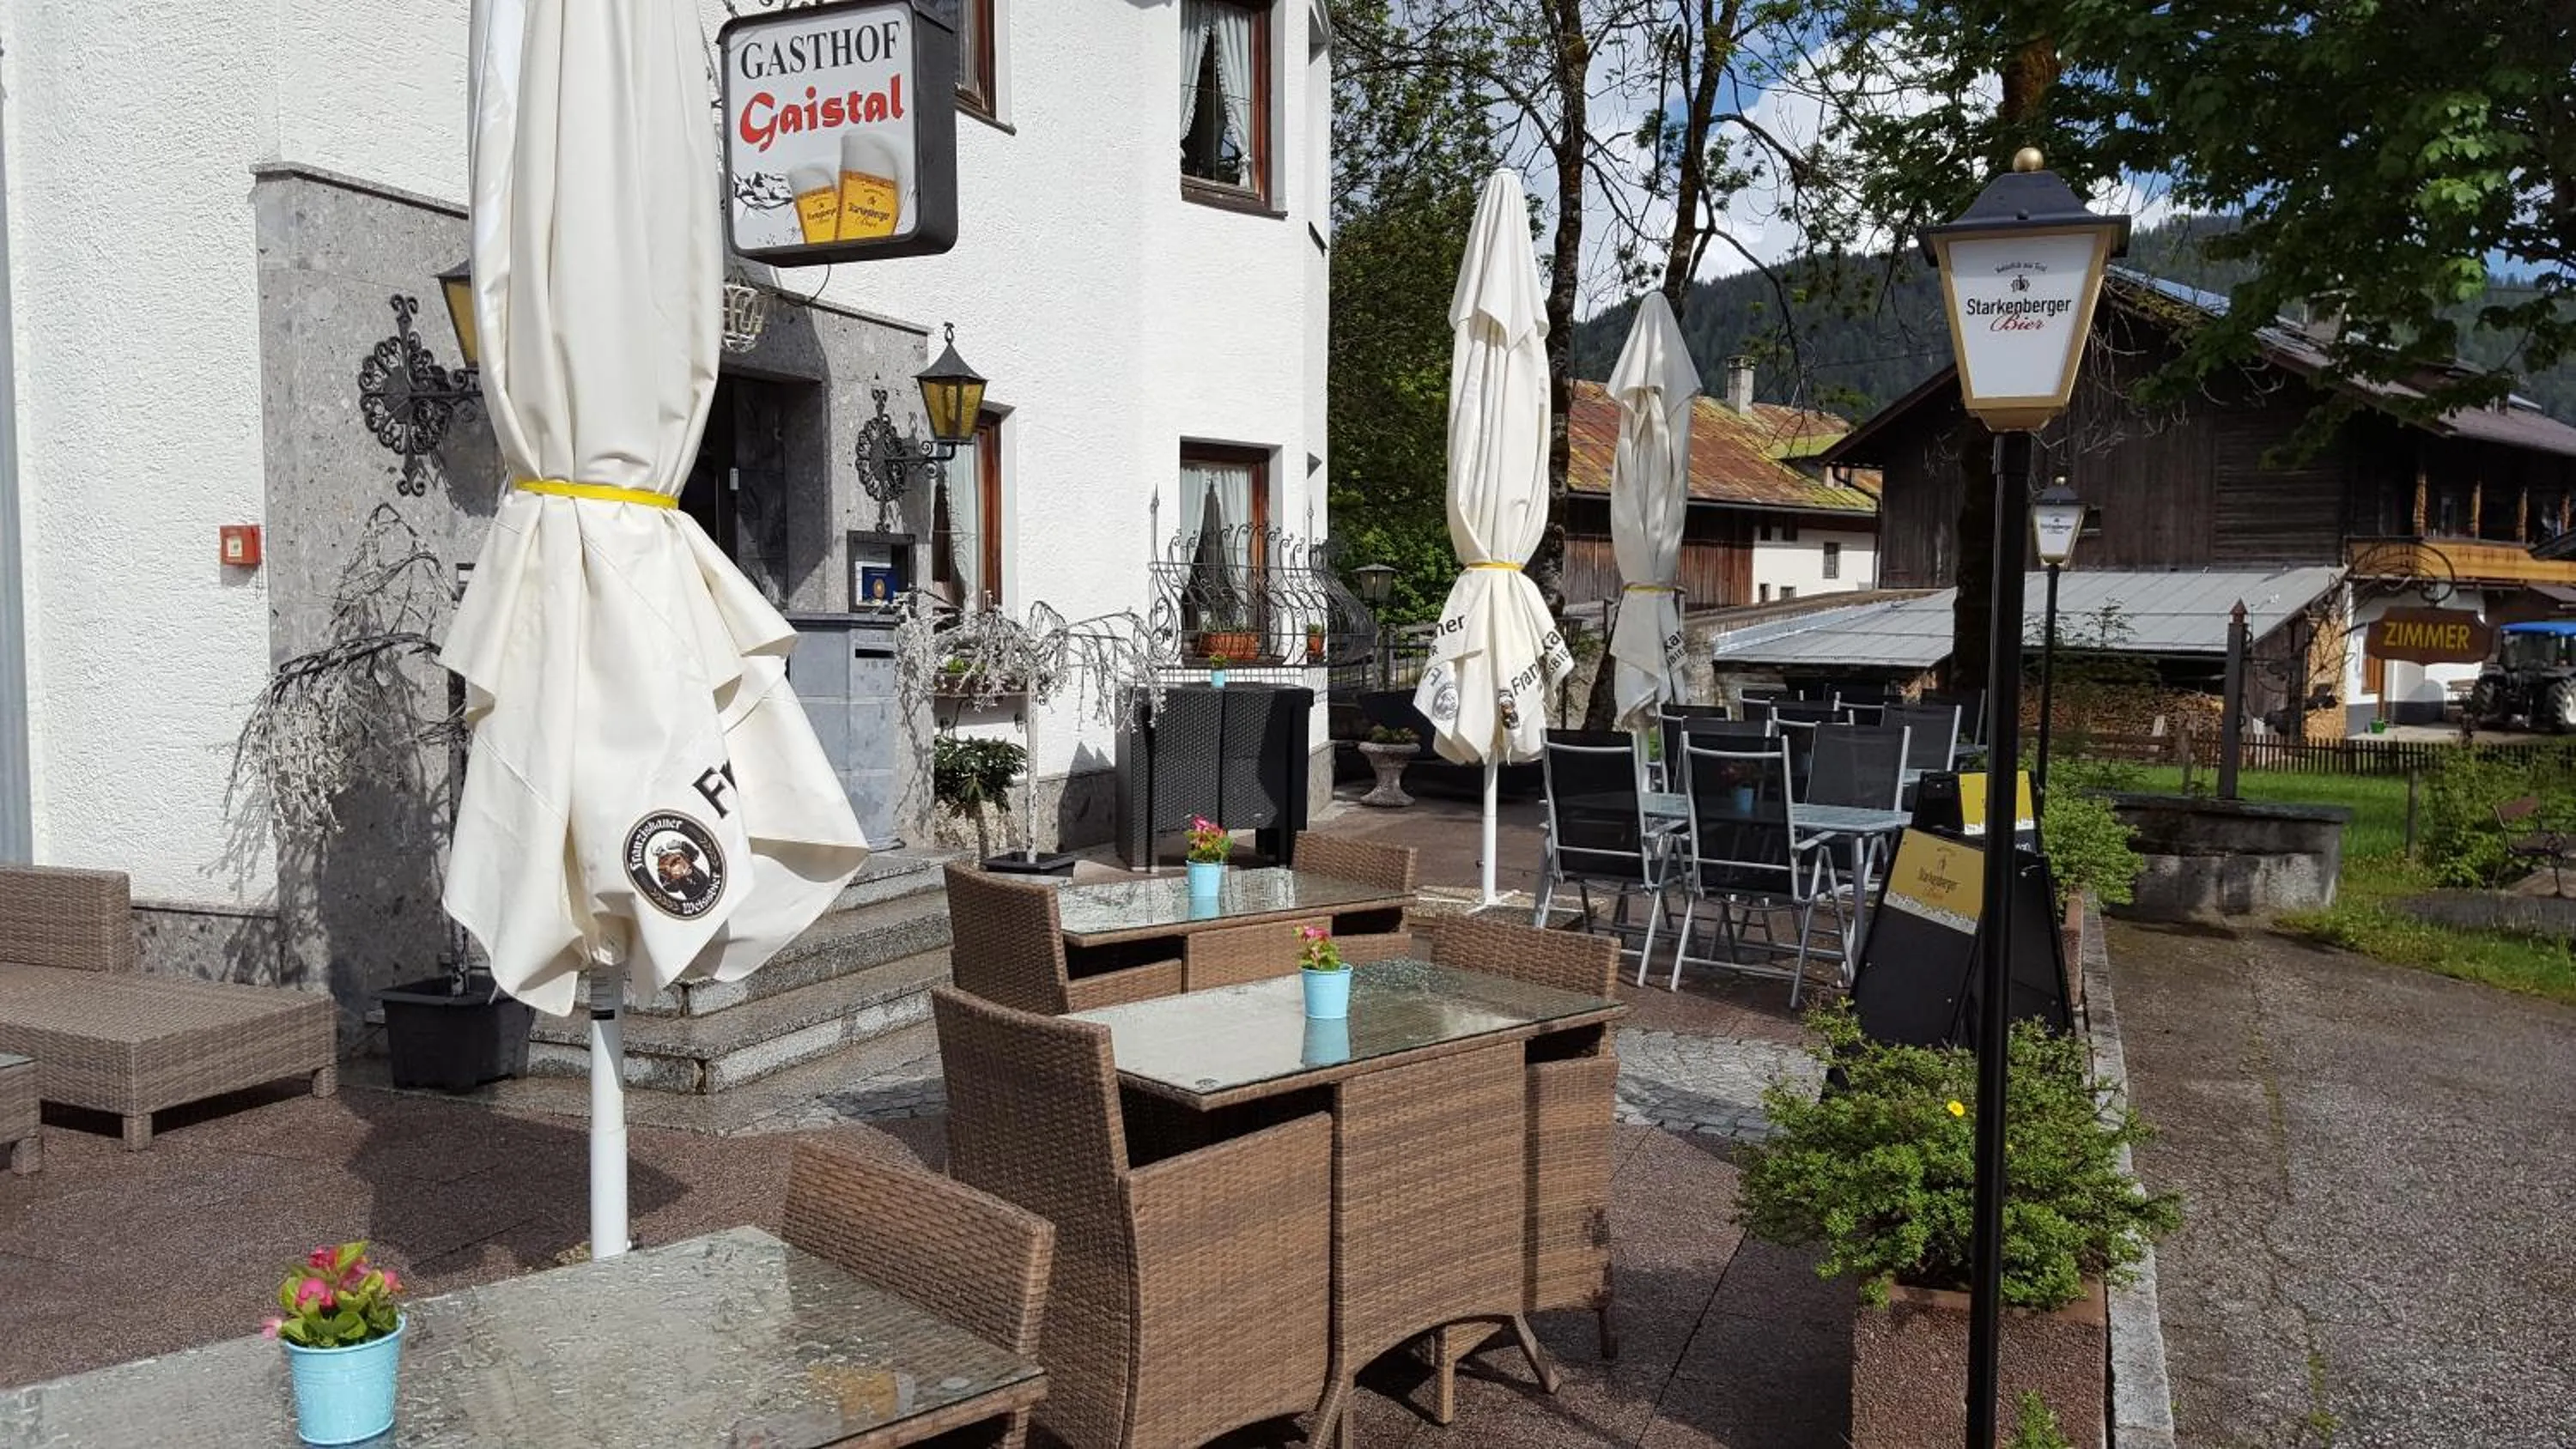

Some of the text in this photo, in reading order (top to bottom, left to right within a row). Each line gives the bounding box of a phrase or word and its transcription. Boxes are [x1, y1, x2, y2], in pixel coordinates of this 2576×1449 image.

[740, 21, 901, 80] GASTHOF
[739, 73, 904, 153] Gaistal
[1966, 298, 2072, 317] Starkenberger
[1990, 314, 2044, 332] Bier
[2383, 621, 2471, 650] ZIMMER
